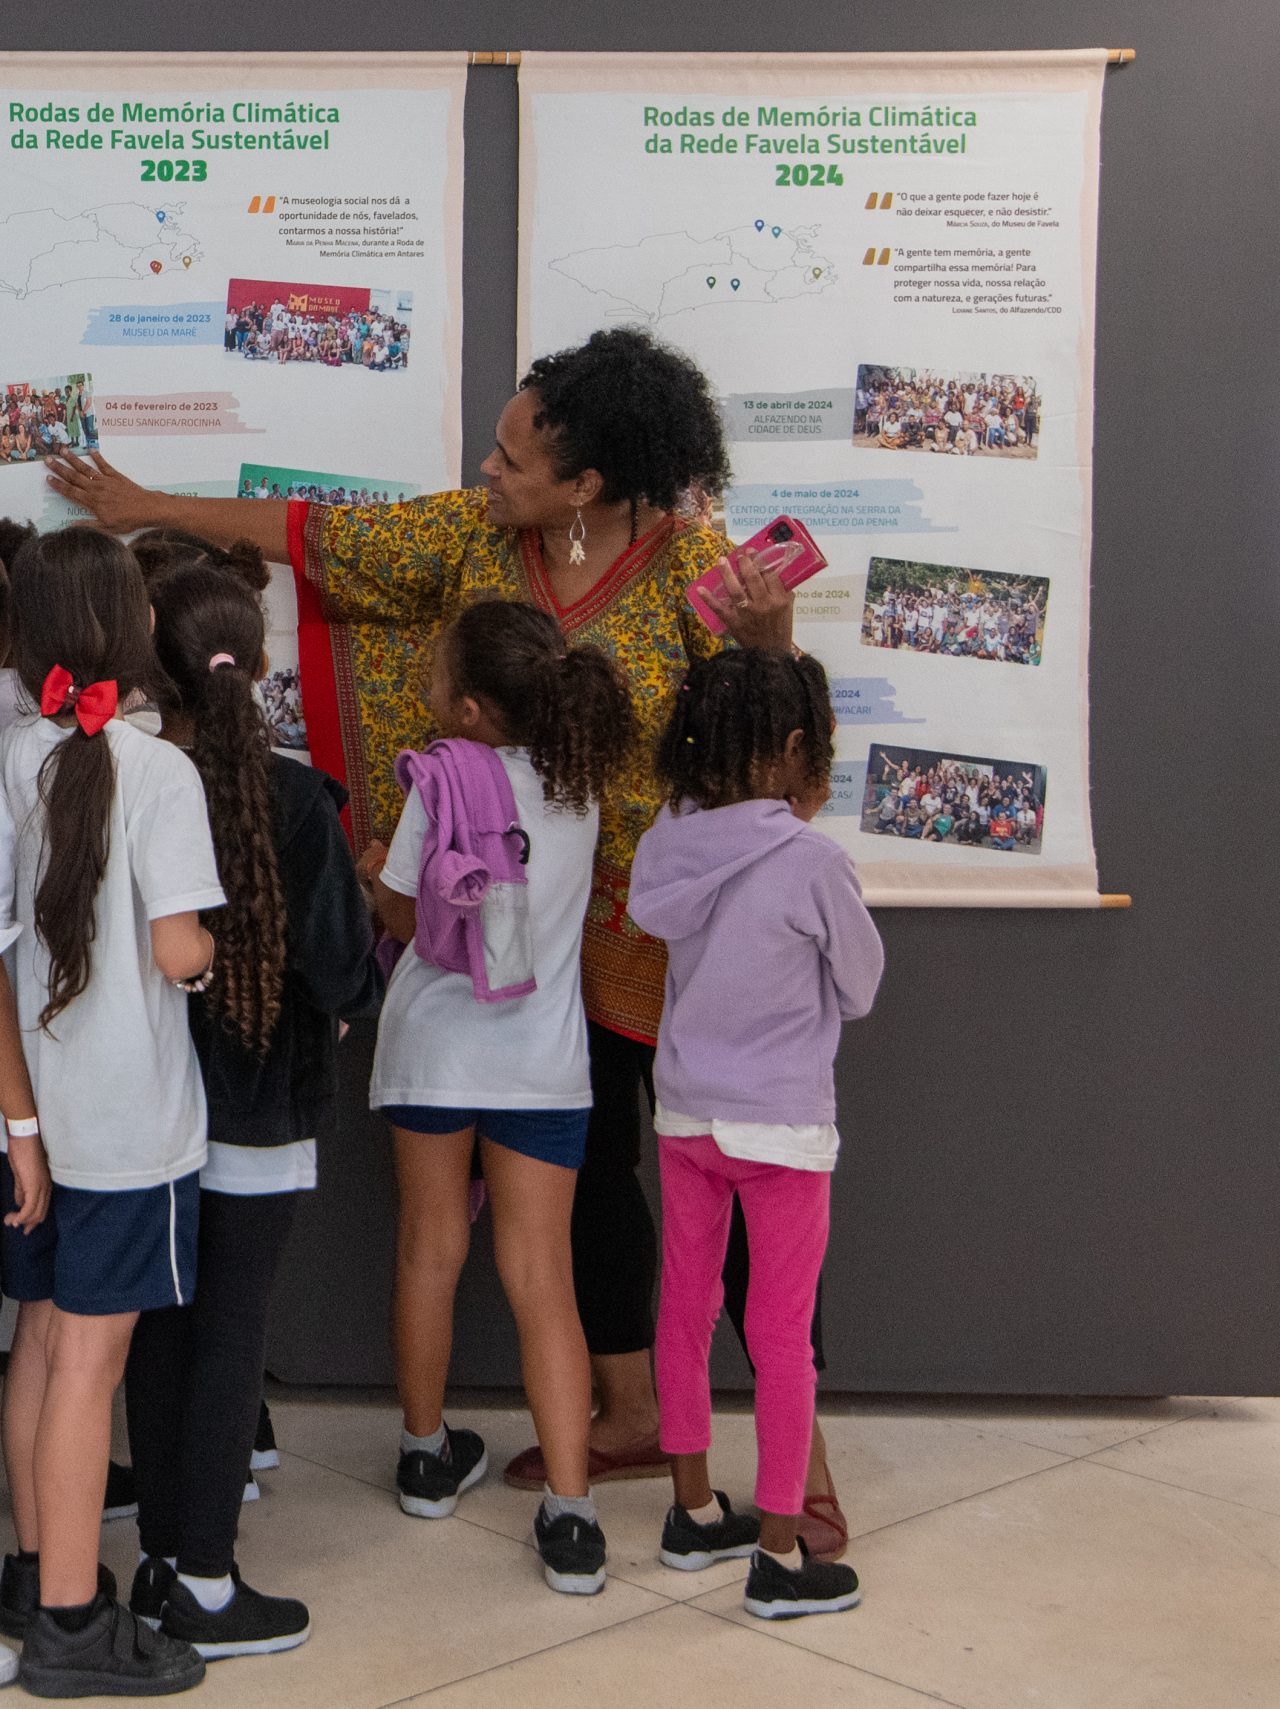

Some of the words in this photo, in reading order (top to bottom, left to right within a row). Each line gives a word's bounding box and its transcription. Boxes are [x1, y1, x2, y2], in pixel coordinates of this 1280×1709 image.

[10, 102, 80, 122] Rodas
[87, 102, 114, 122] de
[122, 102, 225, 123] Memória
[233, 102, 339, 123] Climática
[644, 106, 715, 127] Rodas
[722, 106, 750, 126] de
[758, 106, 861, 127] Memória
[869, 106, 976, 126] Climática
[11, 129, 38, 149] da
[46, 129, 103, 149] Rede
[111, 129, 184, 149] Favela
[192, 129, 328, 150] Sustentável
[645, 133, 672, 153] da
[680, 133, 738, 154] Rede
[746, 134, 820, 154] Favela
[827, 133, 965, 154] Sustentável
[141, 160, 207, 182] 2023
[776, 164, 844, 186] 2024
[292, 197, 342, 207] museologia
[344, 196, 369, 205] social
[389, 196, 400, 204] dá
[910, 194, 926, 202] que
[936, 193, 961, 202] gente
[963, 193, 985, 202] pode
[988, 192, 1010, 200] fazer
[1012, 192, 1031, 202] hoje
[1033, 192, 1039, 200] é
[279, 212, 337, 221] oportunidade
[340, 212, 350, 220] de
[374, 211, 418, 220] favelados,
[896, 207, 912, 216] não
[915, 208, 942, 216] deixar
[944, 209, 985, 218] esquecer,
[996, 207, 1012, 216] não
[279, 227, 326, 235] contarmos
[906, 249, 932, 259] gente
[954, 248, 995, 257] memória,
[1006, 249, 1031, 259] gente
[894, 263, 946, 273] compartilha
[971, 263, 1013, 271] memória!
[894, 280, 931, 288] proteger
[962, 279, 983, 287] vida,
[1014, 278, 1045, 288] relação
[922, 294, 963, 303] natureza,
[973, 294, 1013, 304] gerações
[109, 314, 121, 322] 28
[124, 314, 135, 322] de
[137, 314, 170, 324] janeiro
[172, 314, 184, 322] de
[186, 314, 211, 322] 2023
[123, 328, 154, 336] MUSEU
[157, 328, 169, 336] DA
[171, 326, 196, 336] MARÉ
[106, 402, 118, 410] 04
[135, 402, 177, 410] fevereiro
[743, 401, 754, 409] 13
[756, 401, 768, 409] de
[770, 401, 791, 409] abril
[794, 401, 806, 409] de
[808, 401, 832, 409] 2024
[102, 418, 133, 427] MUSEU
[136, 417, 221, 427] SANKOFA/ROCINHA
[754, 415, 807, 423] ALFAZENDO
[809, 415, 822, 423] NA
[748, 425, 781, 433] CIDADE
[783, 425, 795, 433] DE
[797, 425, 821, 434] DEUS
[772, 489, 778, 498] 4
[780, 490, 792, 498] de
[794, 490, 817, 498] maio
[820, 490, 832, 498] de
[834, 489, 859, 498] 2024
[730, 505, 766, 514] CENTRO
[769, 505, 780, 514] DE
[841, 506, 855, 514] NA
[856, 506, 886, 514] SERRA
[888, 506, 901, 514] DA
[852, 517, 864, 526] DA
[866, 517, 898, 526] PENHA
[811, 590, 823, 598] de
[825, 590, 850, 598] 2024
[835, 690, 860, 698] 2024
[830, 774, 852, 783] 024
